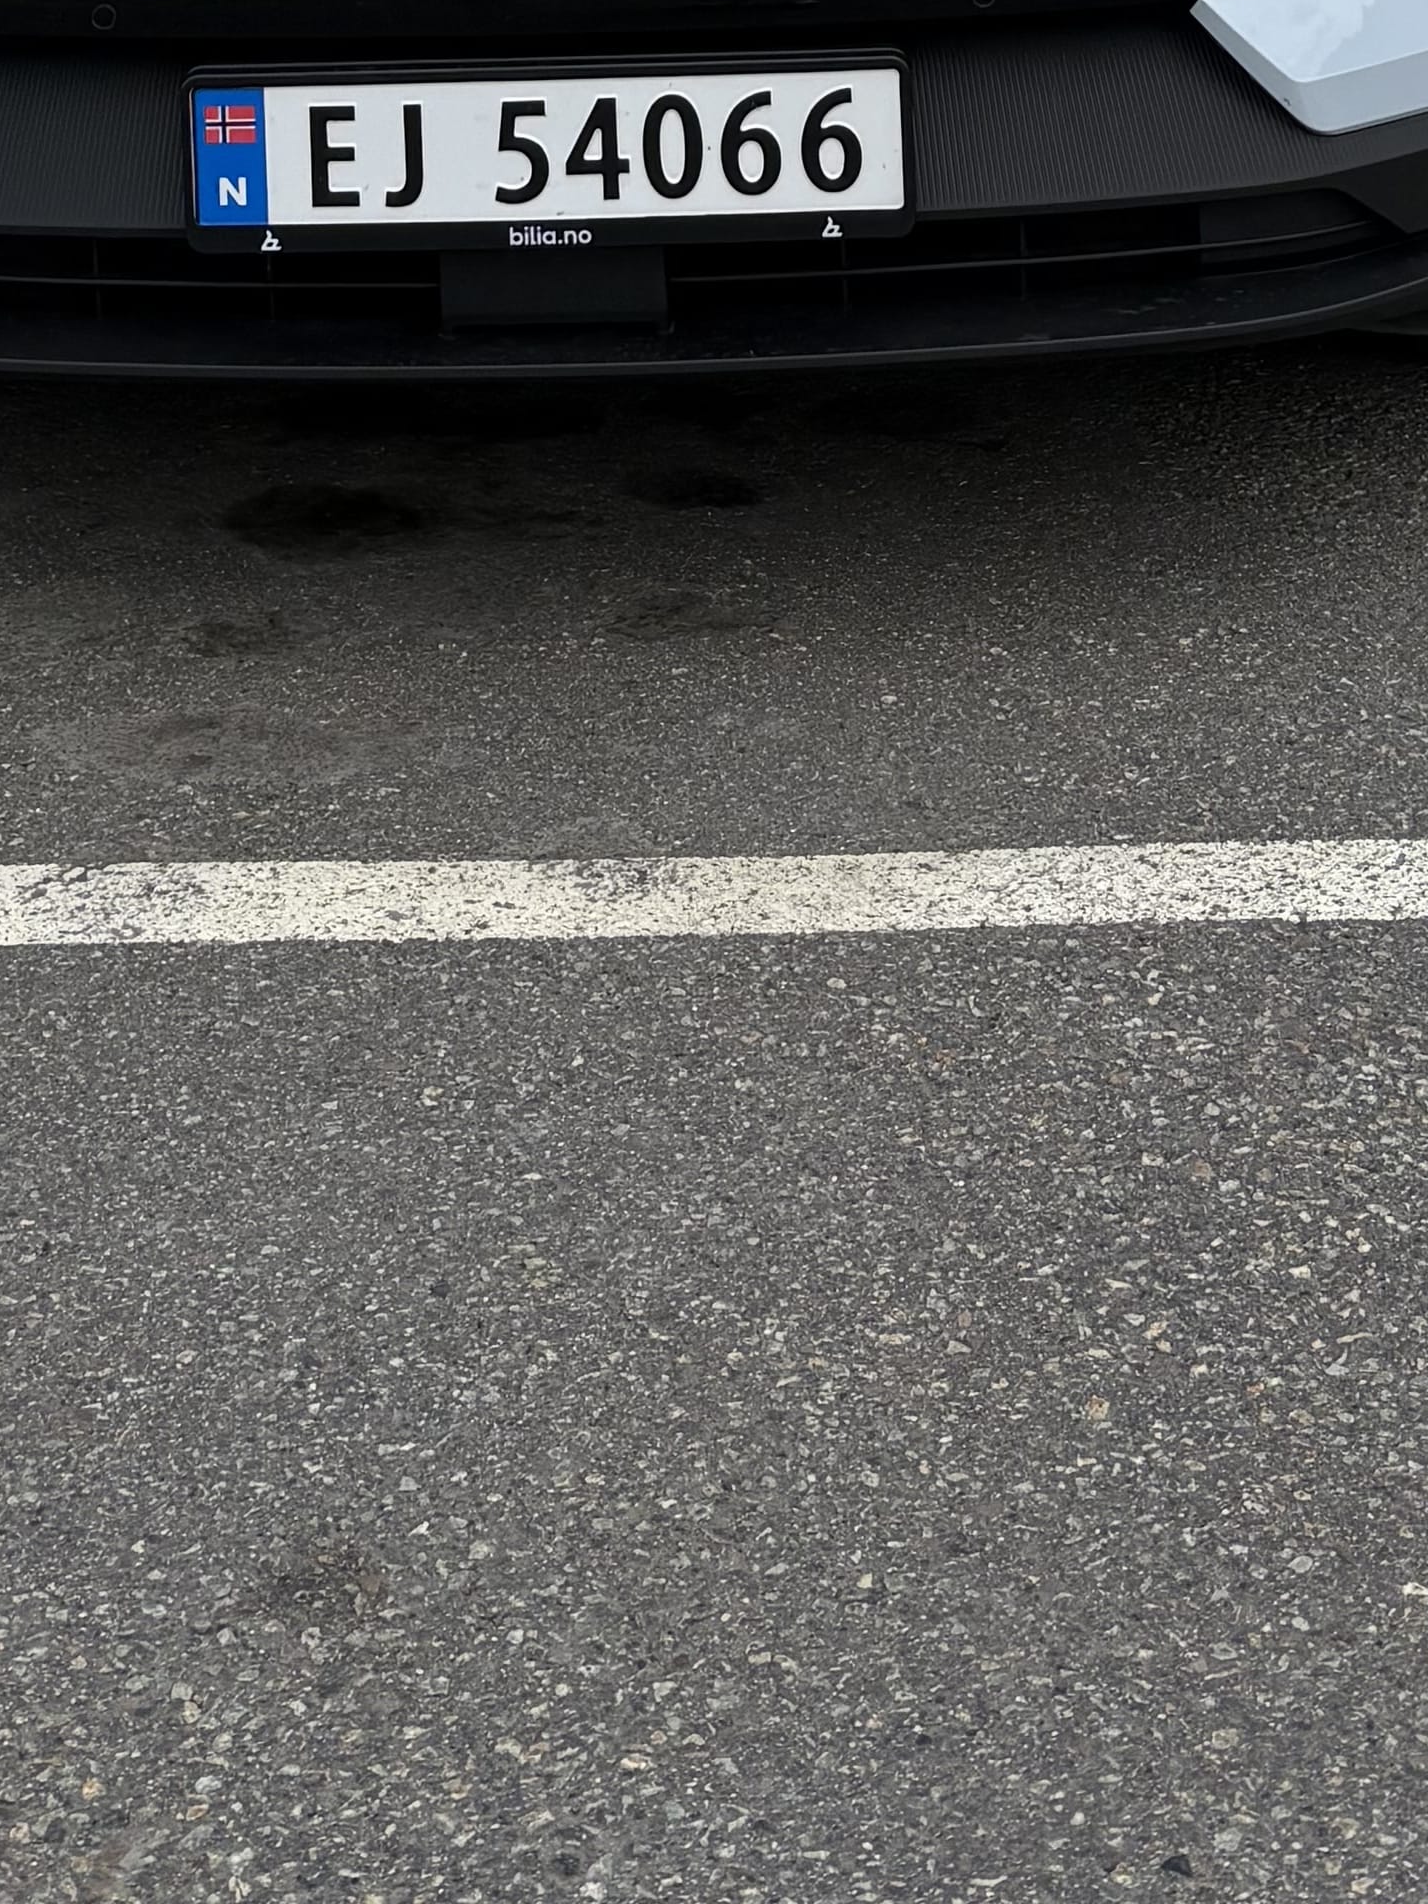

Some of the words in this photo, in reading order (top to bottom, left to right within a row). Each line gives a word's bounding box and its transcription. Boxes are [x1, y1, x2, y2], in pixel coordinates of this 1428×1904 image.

[309, 104, 424, 208] EJ
[495, 87, 862, 205] 54066
[219, 175, 248, 207] N
[509, 225, 592, 246] bilia.no
